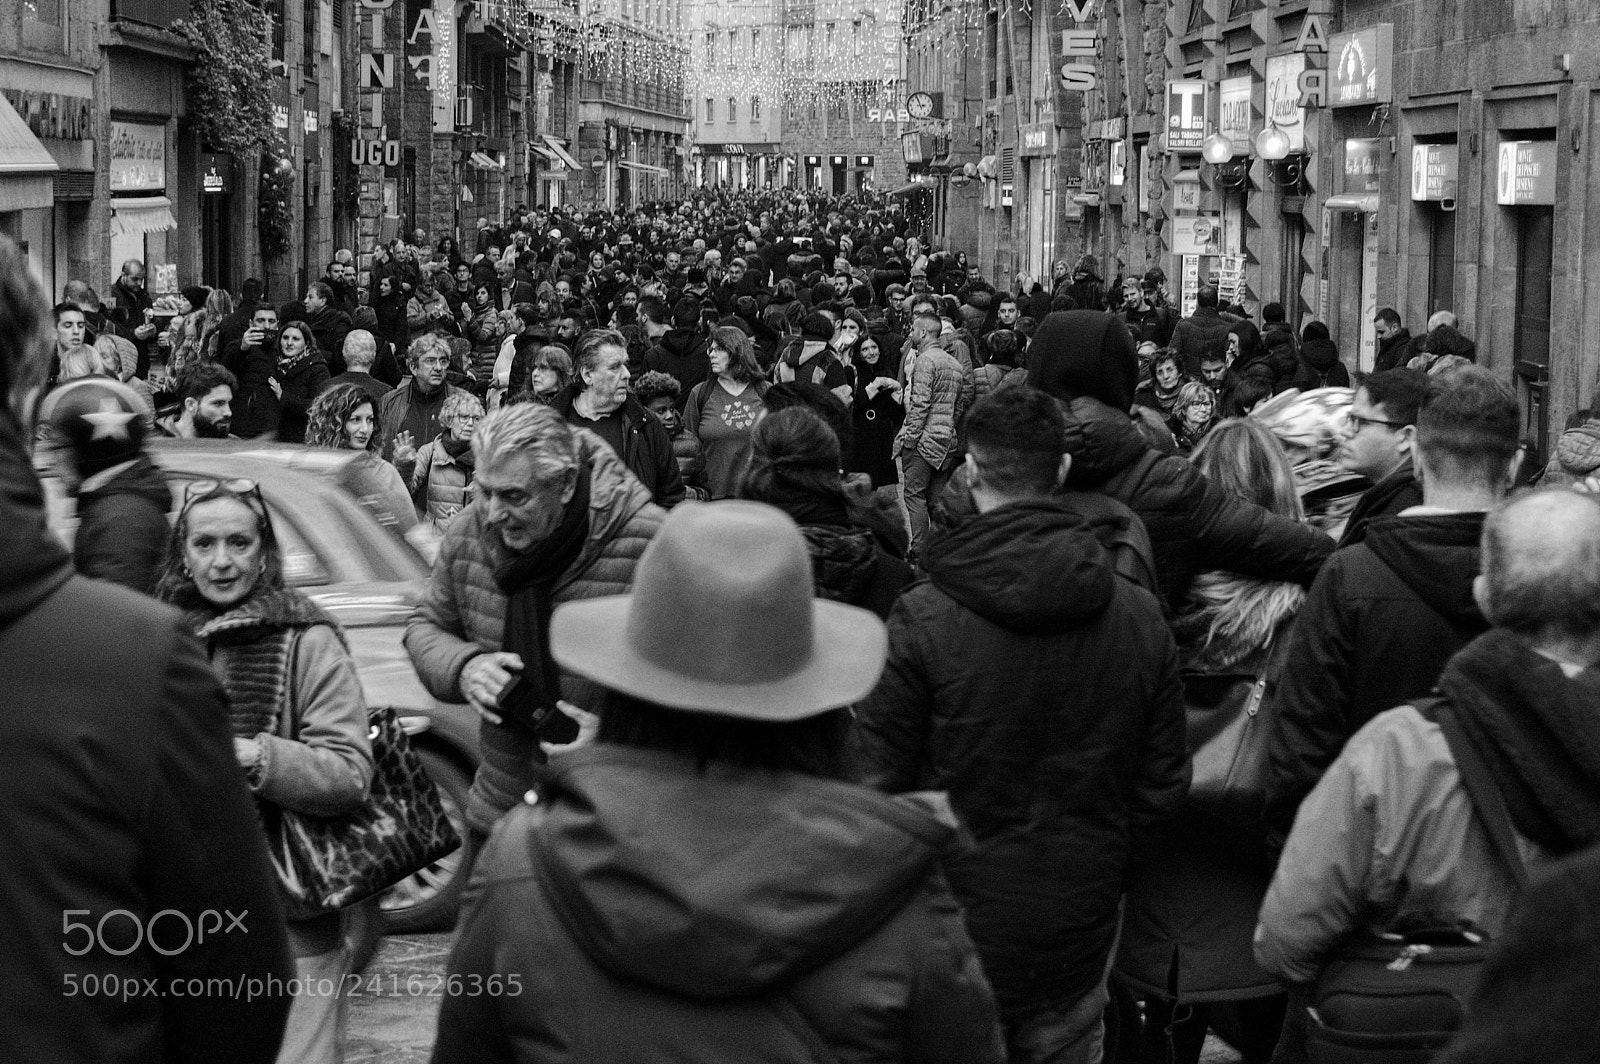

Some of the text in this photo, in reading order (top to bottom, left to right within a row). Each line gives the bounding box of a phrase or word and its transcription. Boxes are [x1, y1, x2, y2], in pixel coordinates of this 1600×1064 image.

[360, 0, 394, 127] INI
[1171, 84, 1203, 129] T
[351, 138, 399, 166] UGO
